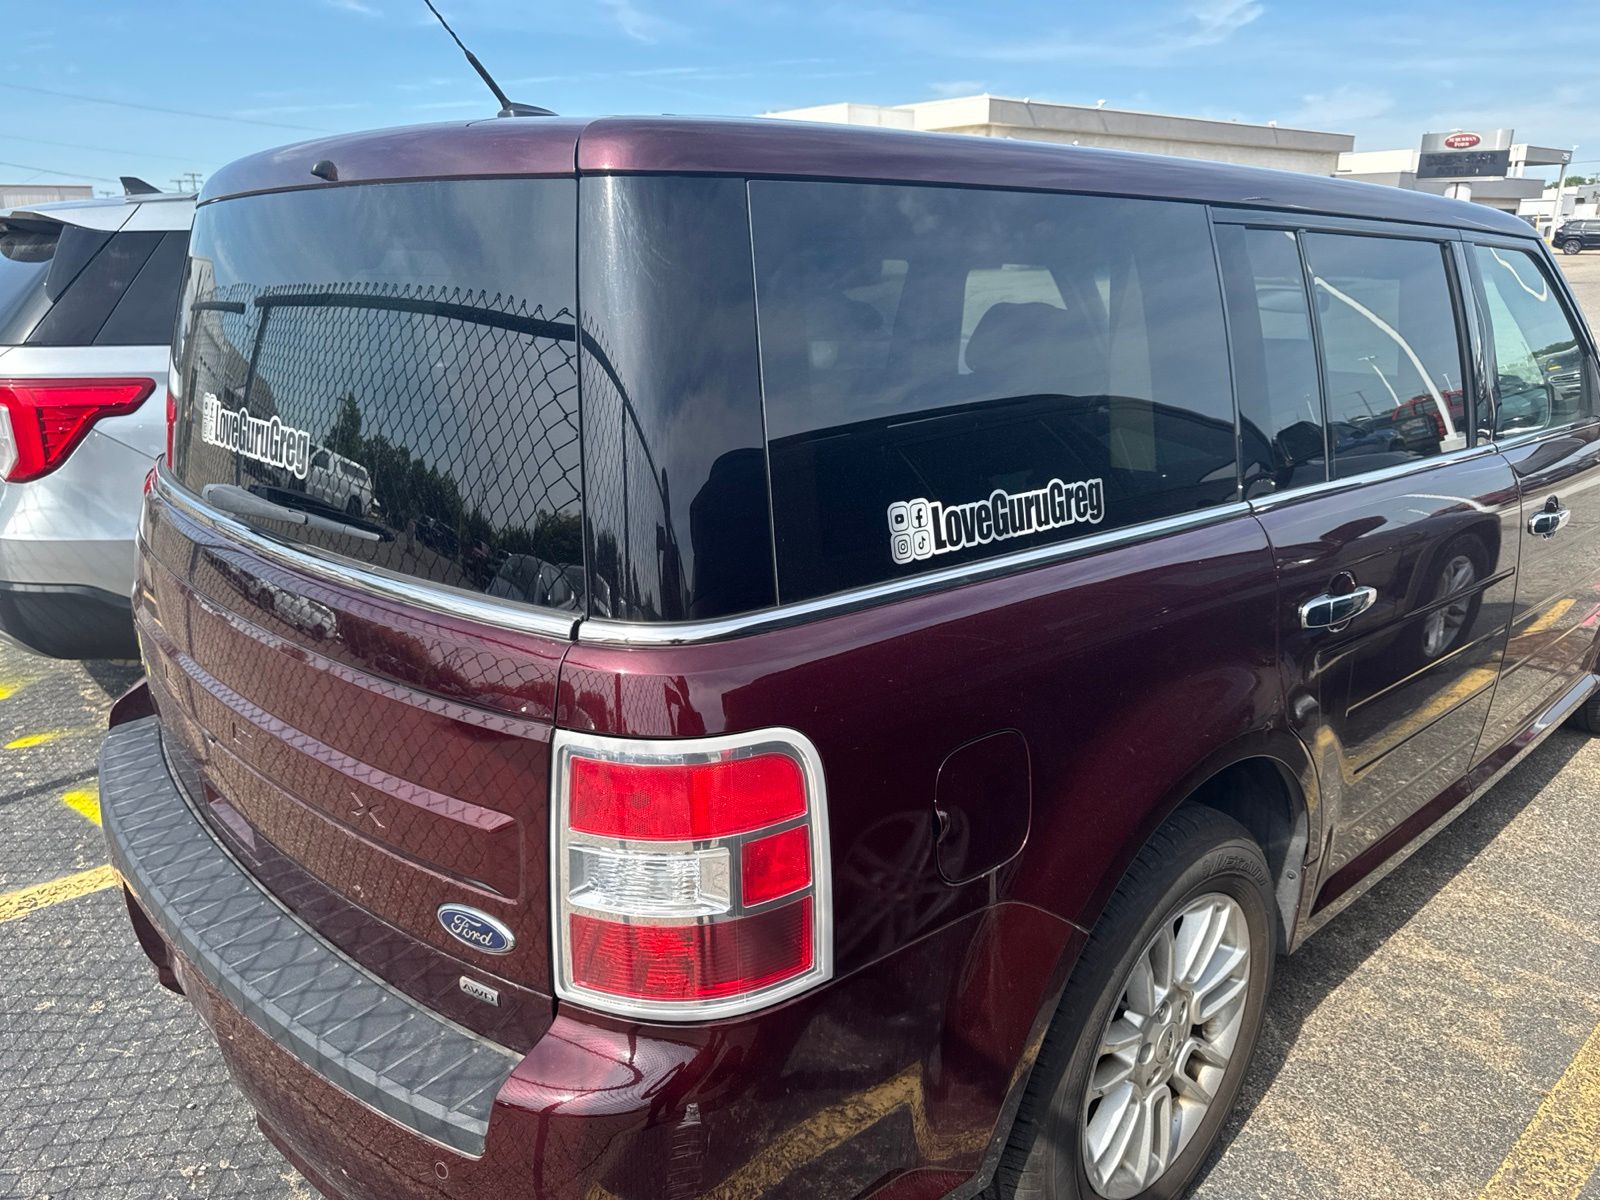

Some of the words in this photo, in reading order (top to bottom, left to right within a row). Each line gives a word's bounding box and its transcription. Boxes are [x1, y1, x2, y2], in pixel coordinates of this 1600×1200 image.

[215, 403, 309, 476] LoveGuruGreg
[931, 481, 1101, 551] LoveGuruGreg
[451, 914, 493, 946] Ford
[463, 983, 495, 1002] AWD
